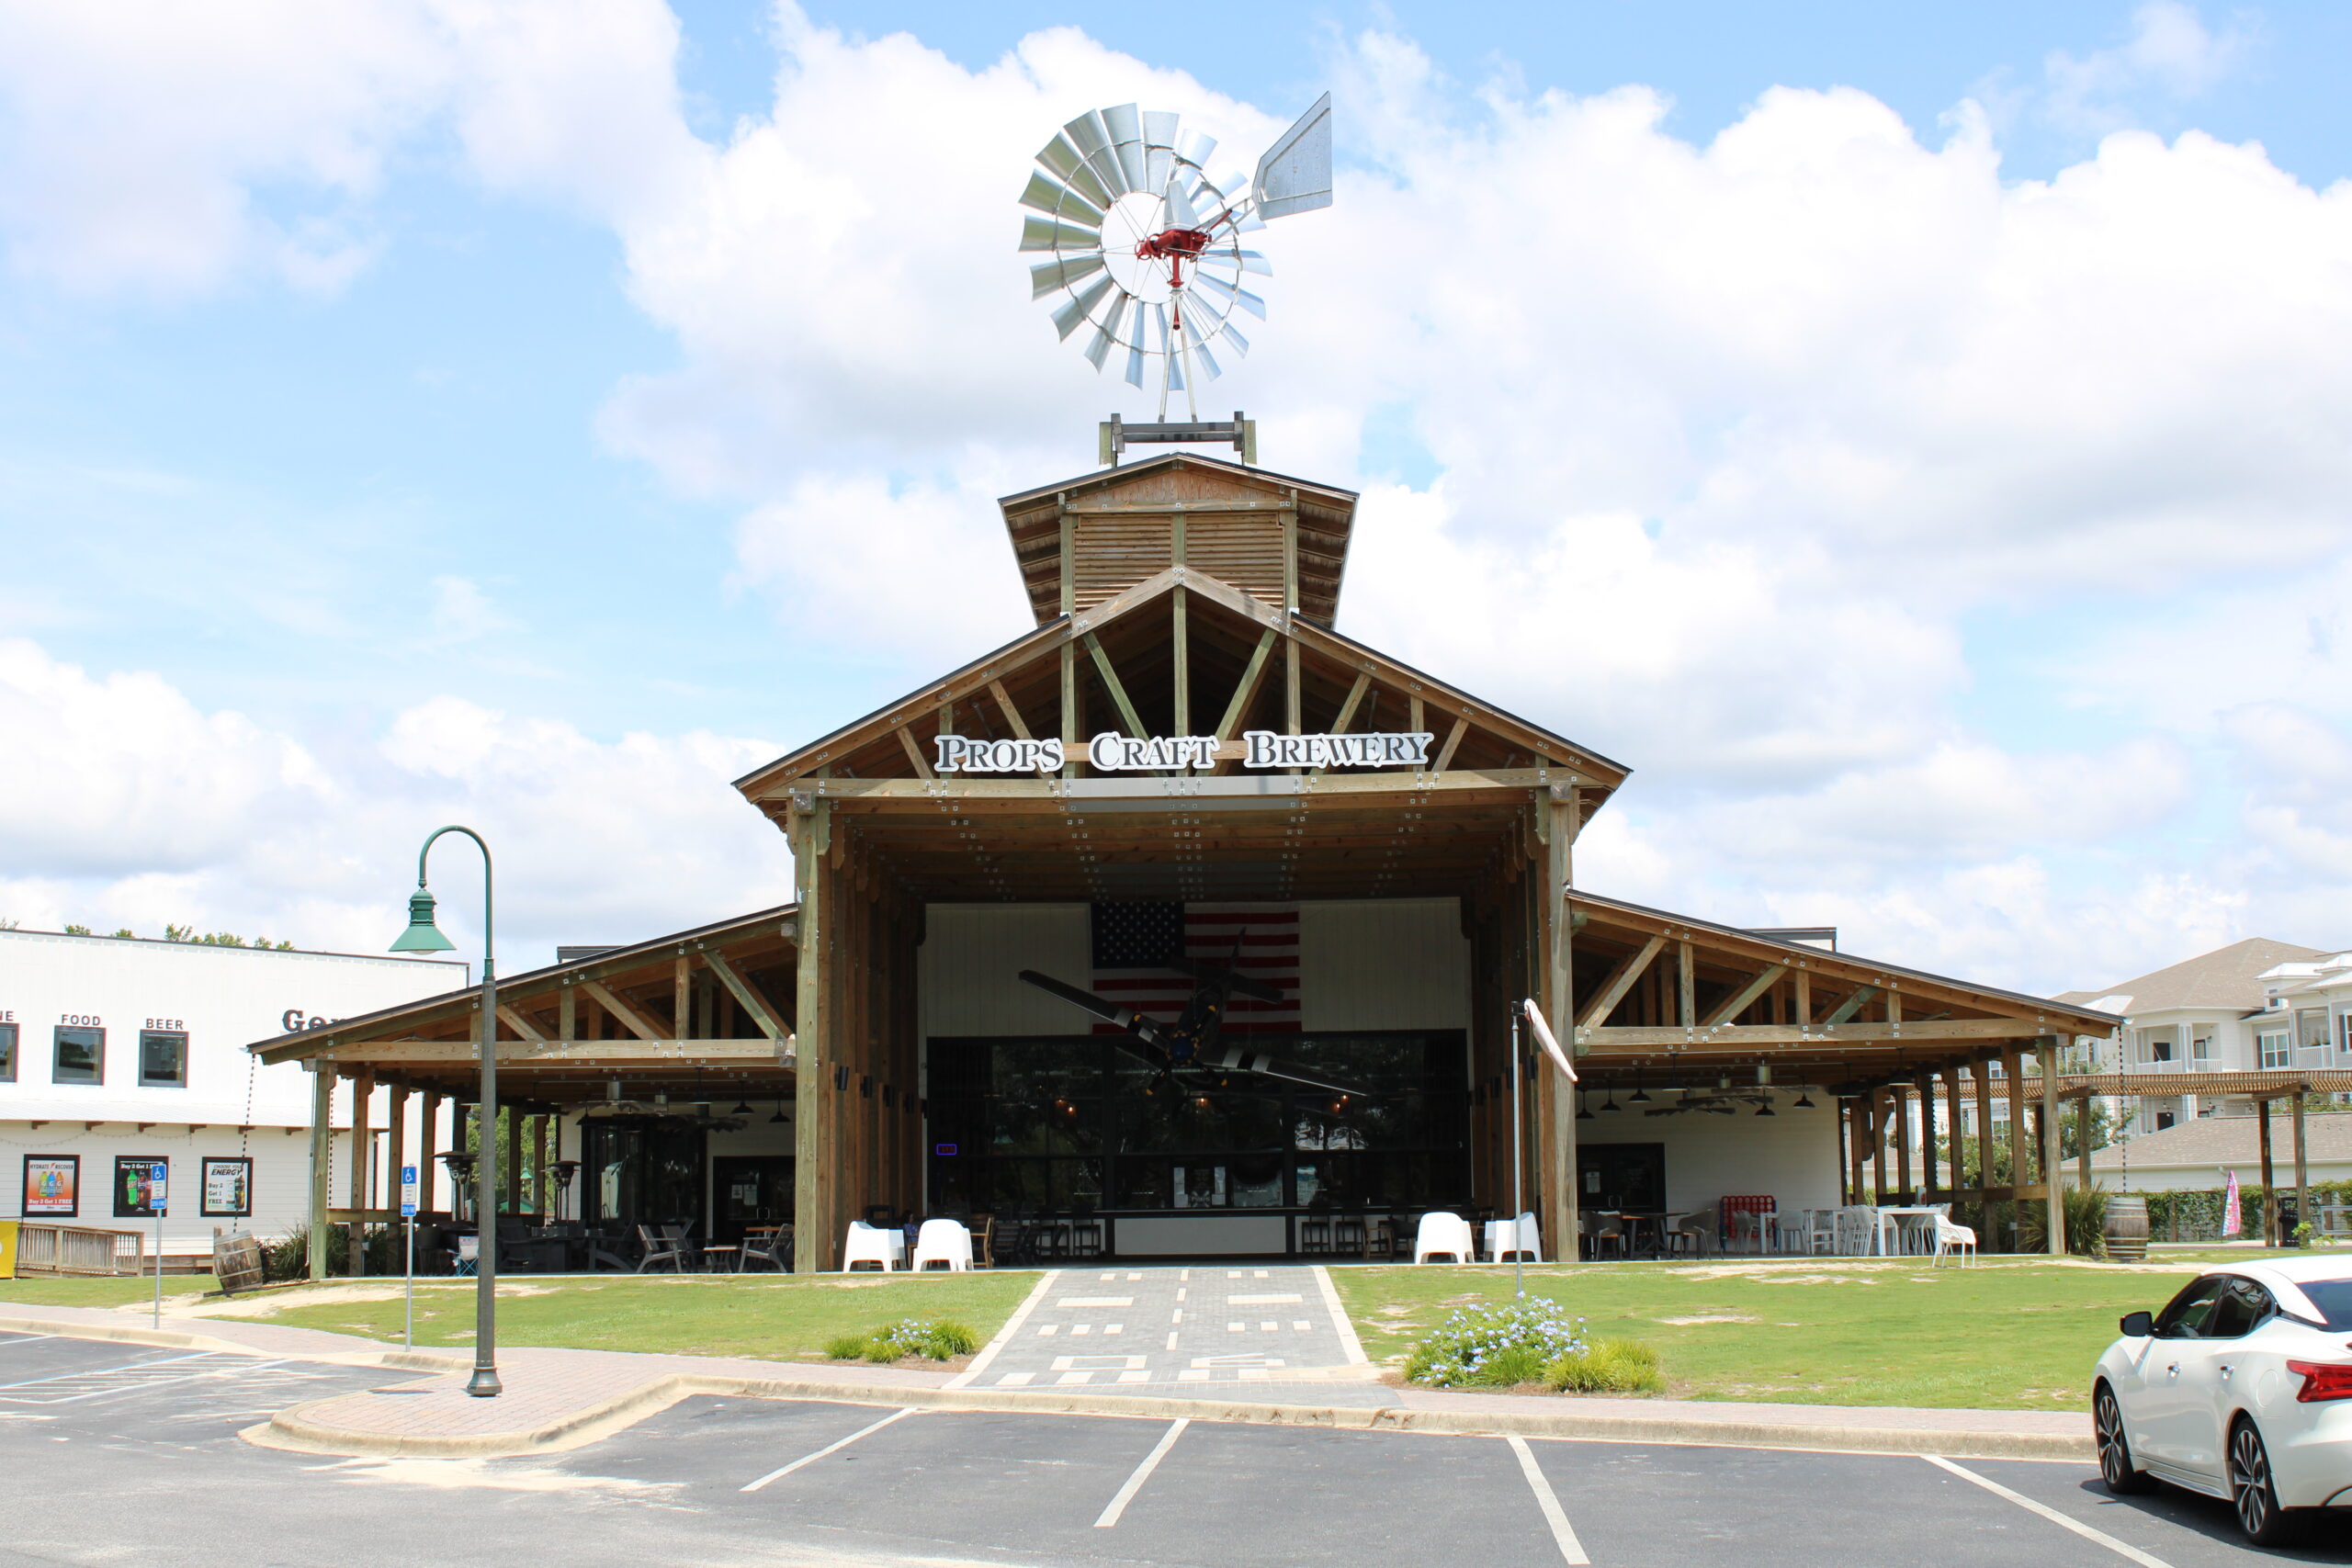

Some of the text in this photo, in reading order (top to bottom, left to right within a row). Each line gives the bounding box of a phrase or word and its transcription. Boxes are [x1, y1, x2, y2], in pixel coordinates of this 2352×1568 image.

[1091, 735, 1217, 767] CRAFT
[1250, 734, 1430, 766] BREWERY
[61, 1014, 101, 1026] FOOD
[145, 1018, 184, 1030] BEER
[282, 1010, 347, 1032] Ge
